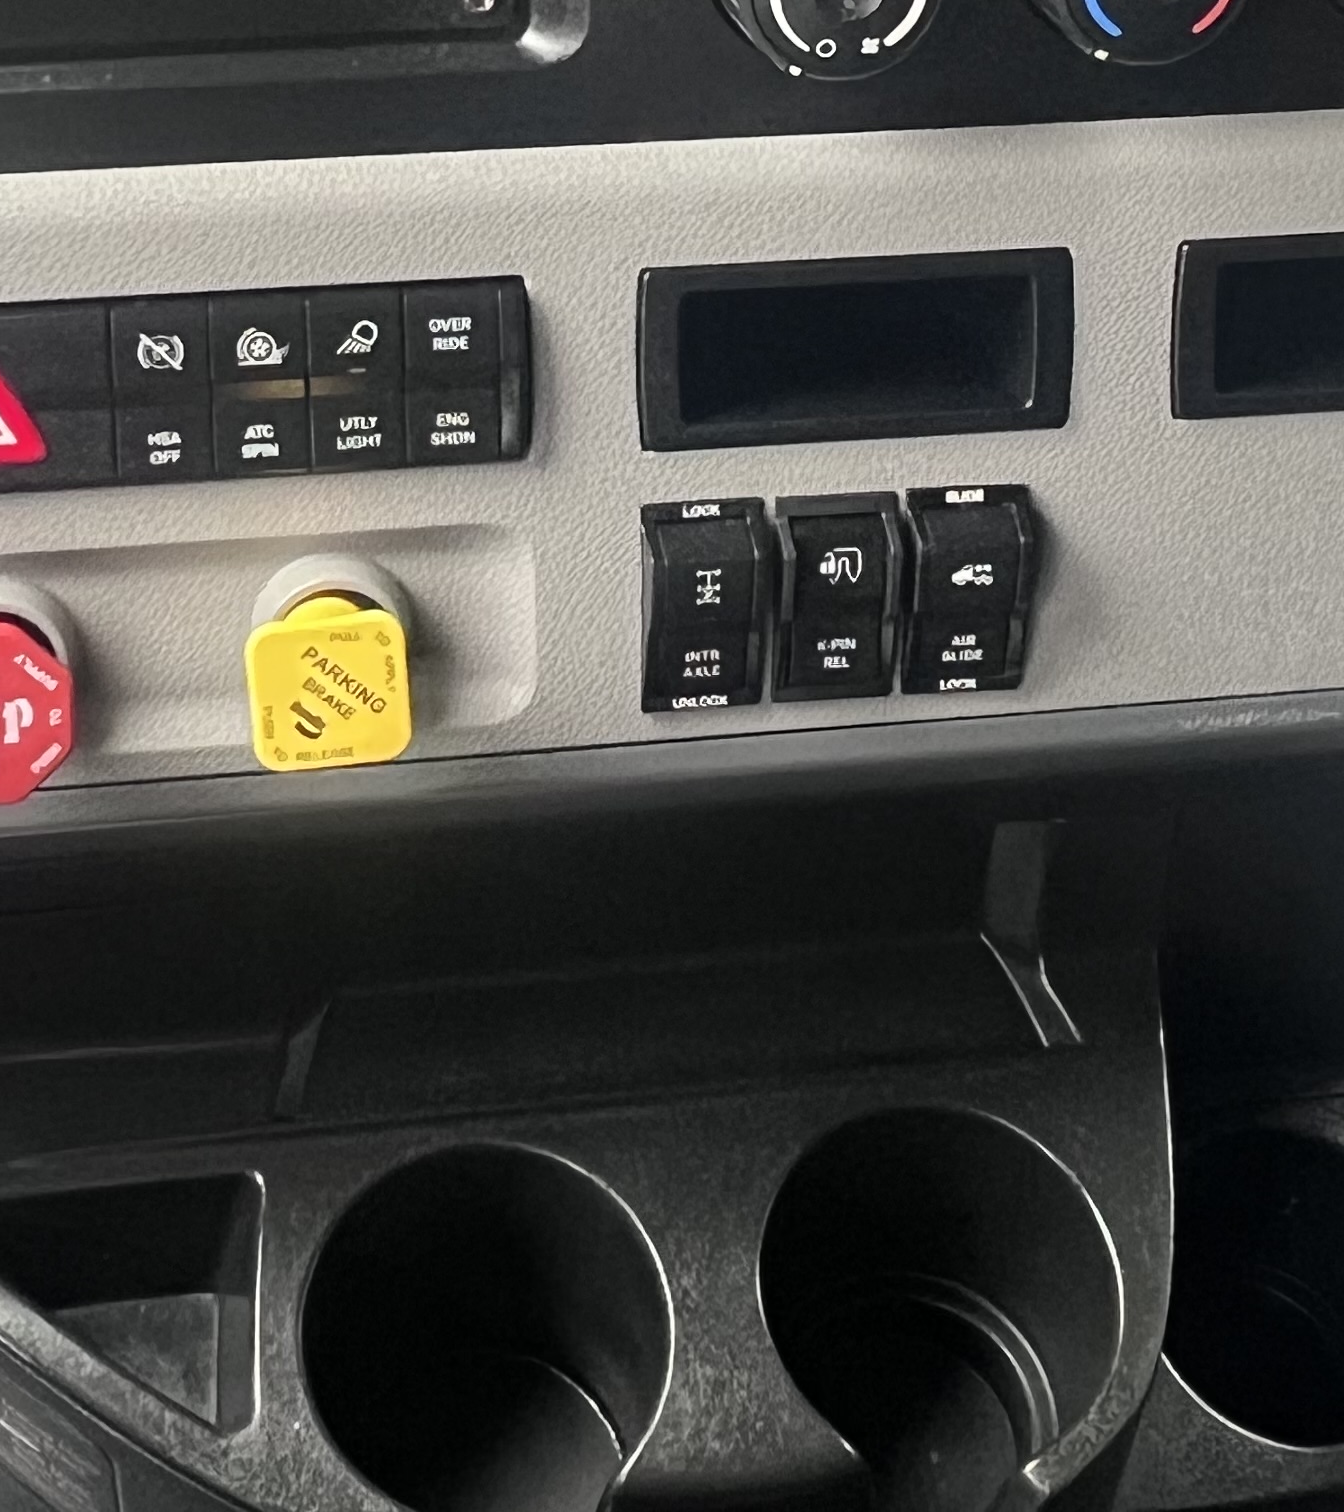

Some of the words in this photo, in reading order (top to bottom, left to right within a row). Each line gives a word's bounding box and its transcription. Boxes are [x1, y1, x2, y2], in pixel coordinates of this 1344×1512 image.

[428, 317, 472, 333] OVER
[432, 335, 470, 351] RIDE
[339, 416, 378, 432] UTLY
[436, 412, 470, 427] ENG
[244, 424, 274, 439] ATC
[336, 433, 382, 451] LIGHT
[149, 449, 181, 465] OFF
[682, 503, 721, 518] LOCK
[951, 634, 977, 646] AIR
[824, 656, 850, 669] REL
[301, 646, 387, 714] PARKING
[939, 678, 976, 691] LOCK
[302, 676, 357, 721] BRAKE
